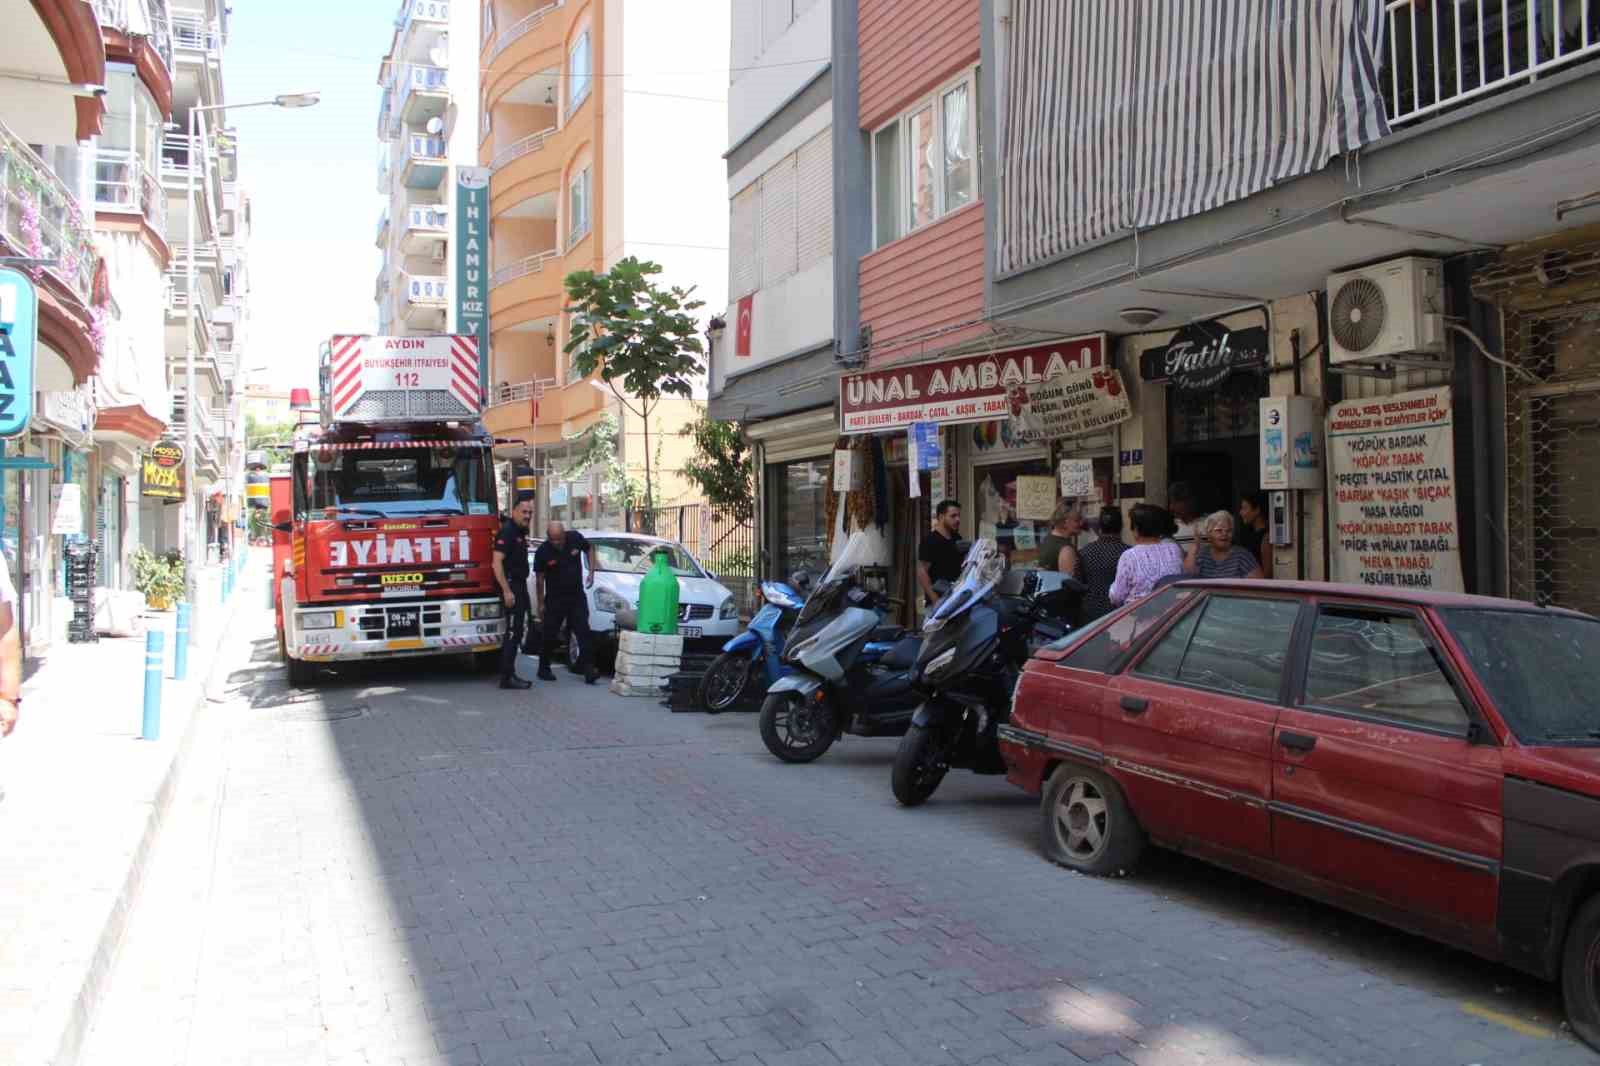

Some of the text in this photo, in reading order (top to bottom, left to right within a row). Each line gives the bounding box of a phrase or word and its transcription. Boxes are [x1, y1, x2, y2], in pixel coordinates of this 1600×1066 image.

[462, 302, 483, 312] KIZ
[385, 340, 425, 349] AYDIN
[1164, 333, 1232, 375] Fatih
[394, 372, 420, 387] 112
[847, 373, 921, 406] ÜNAL
[381, 573, 424, 585] IVECO
